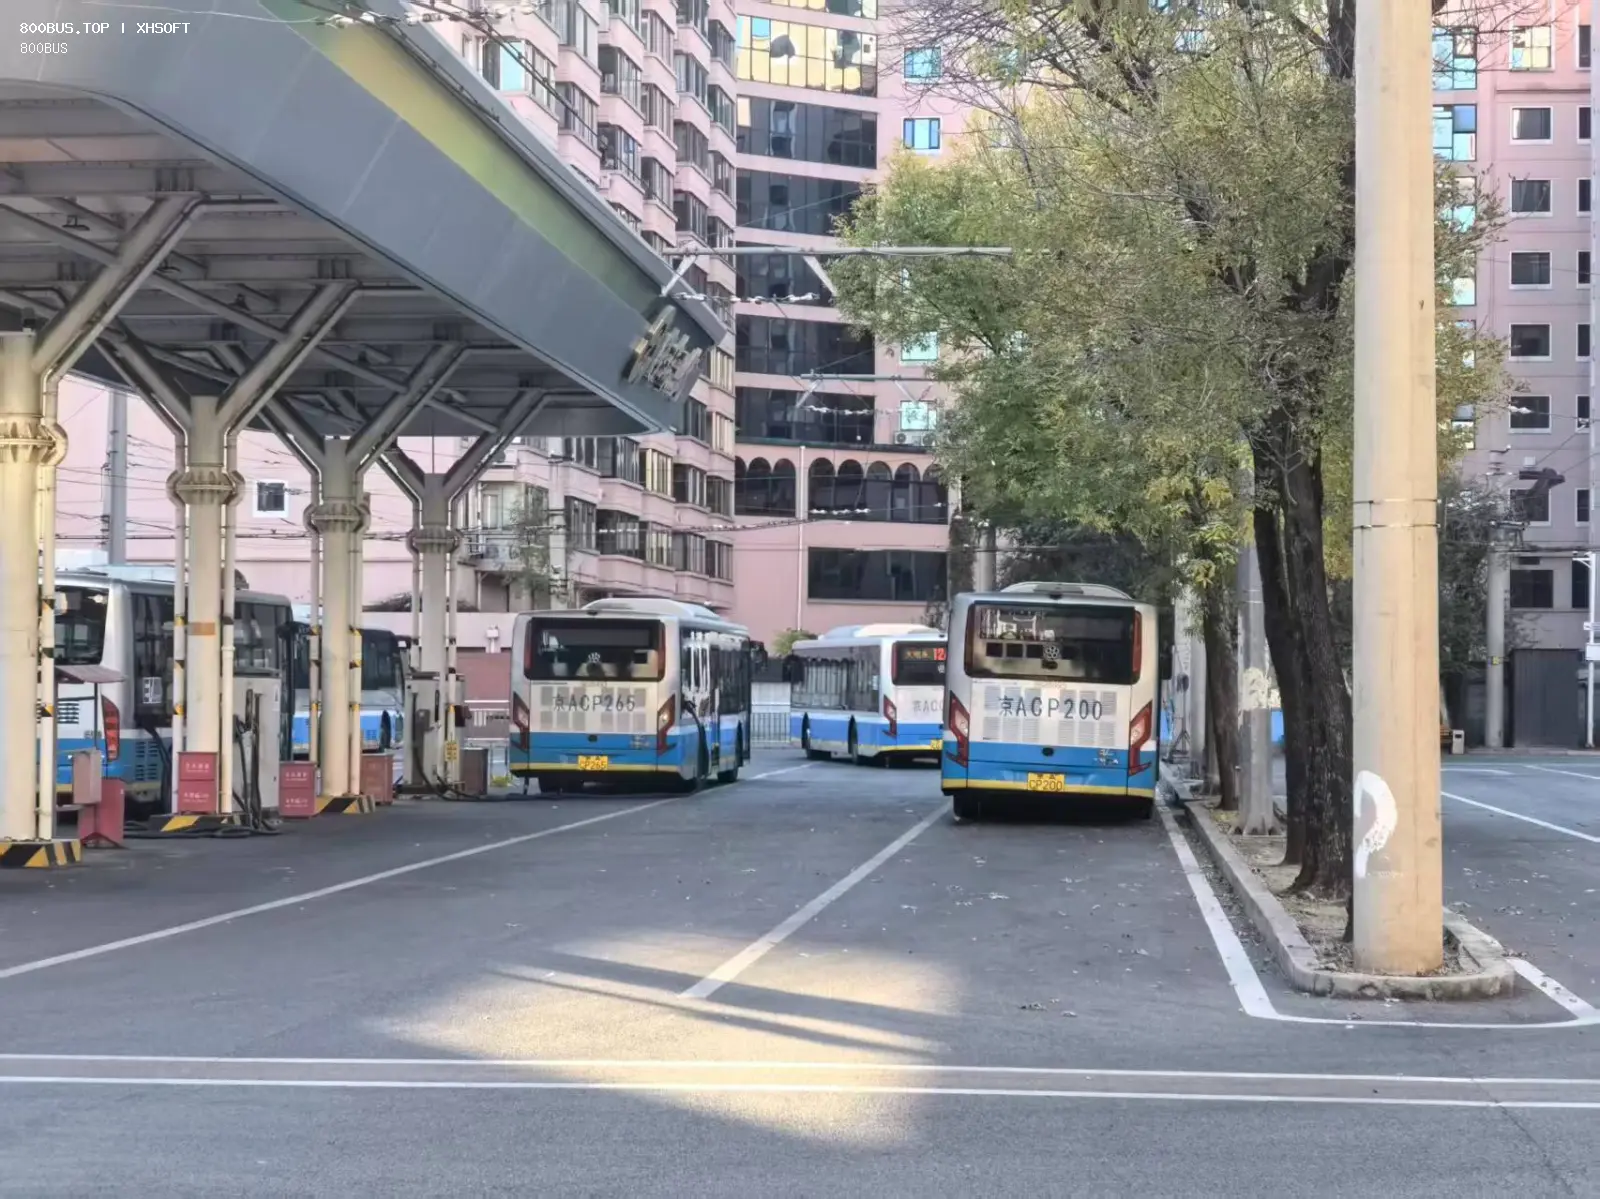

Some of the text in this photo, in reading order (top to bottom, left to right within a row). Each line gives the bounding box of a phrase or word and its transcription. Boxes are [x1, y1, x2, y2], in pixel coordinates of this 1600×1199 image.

[552, 693, 636, 712] 京ACP265
[998, 695, 1103, 720] 京ACP200
[1028, 779, 1063, 791] CP200
